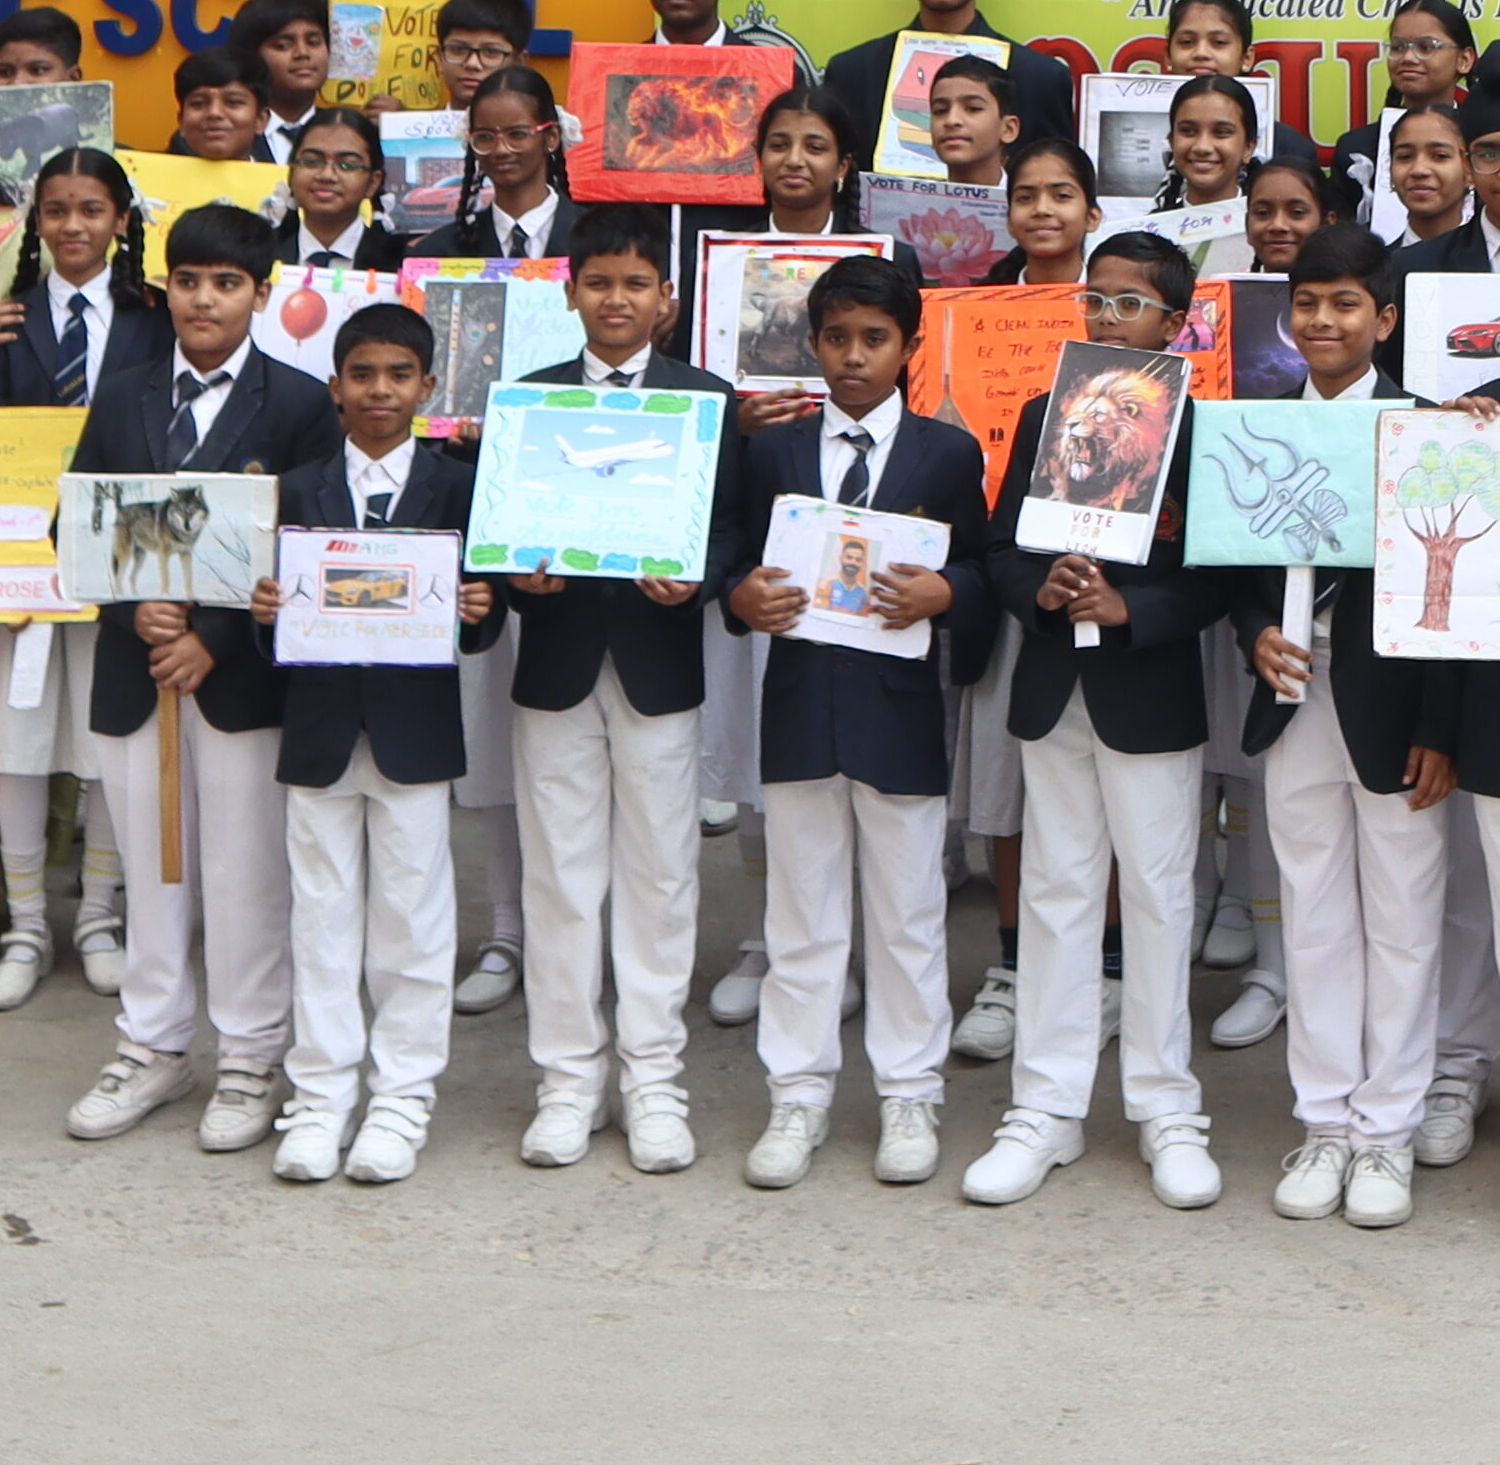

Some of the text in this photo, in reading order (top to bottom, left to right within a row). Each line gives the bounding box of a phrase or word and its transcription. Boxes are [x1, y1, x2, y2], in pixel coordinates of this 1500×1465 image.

[867, 176, 990, 199] VOTE FOR LOTUS
[1072, 511, 1114, 528] VOTE
